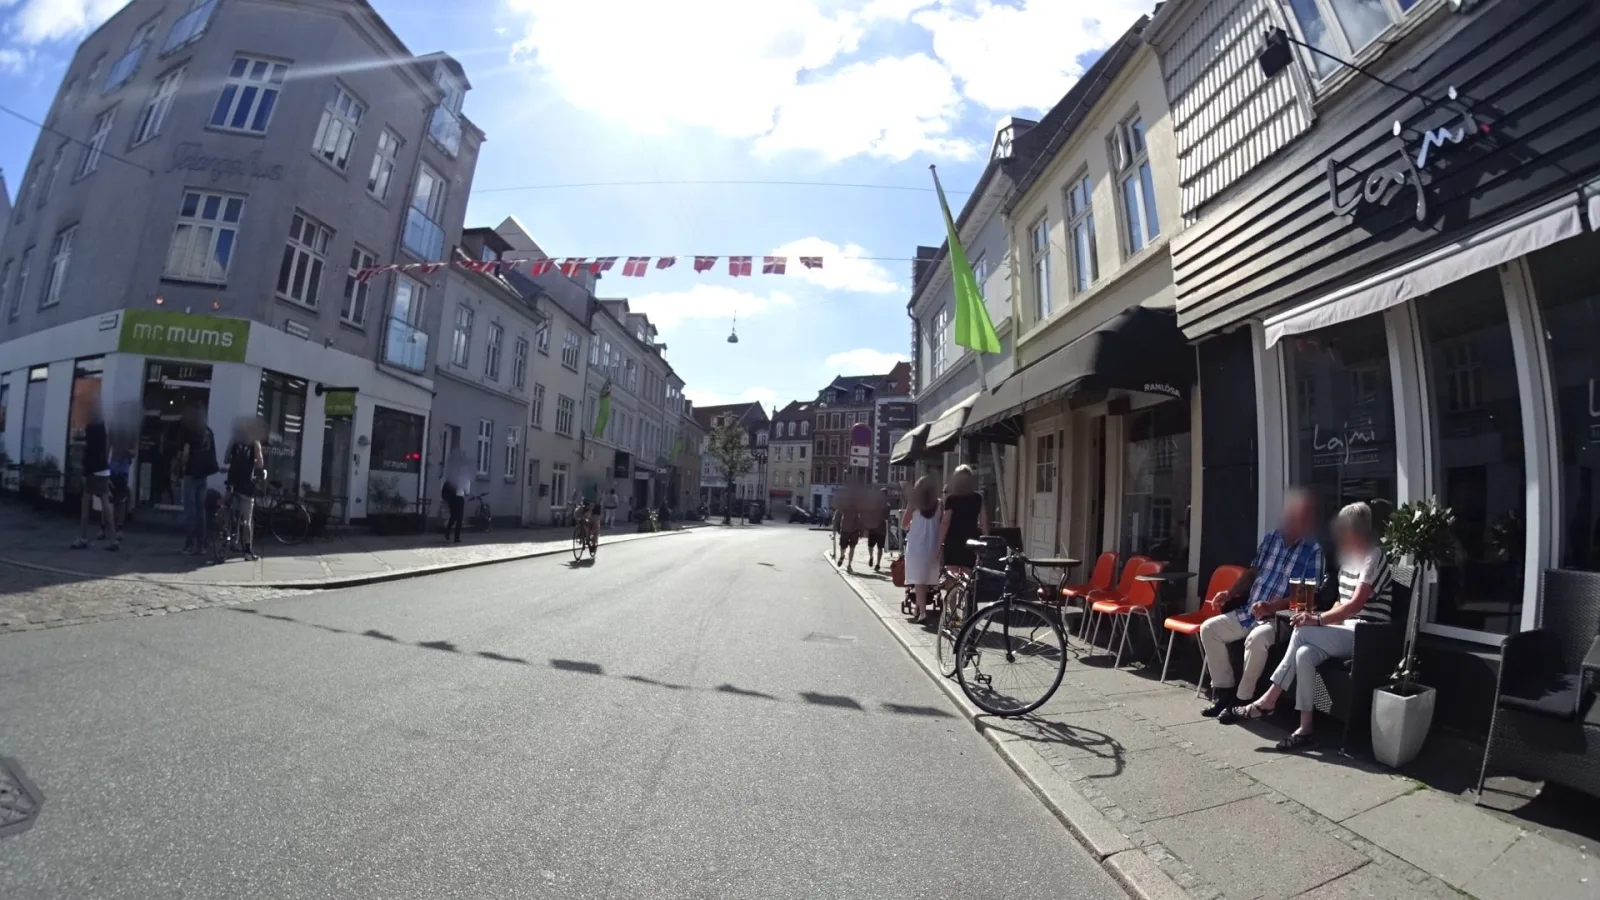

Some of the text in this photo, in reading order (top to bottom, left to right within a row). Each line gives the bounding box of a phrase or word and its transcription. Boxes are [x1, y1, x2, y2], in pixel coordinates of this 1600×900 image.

[167, 326, 234, 347] mums
[1144, 383, 1181, 398] RAMLÖSA
[1313, 416, 1375, 465] Lajmi
